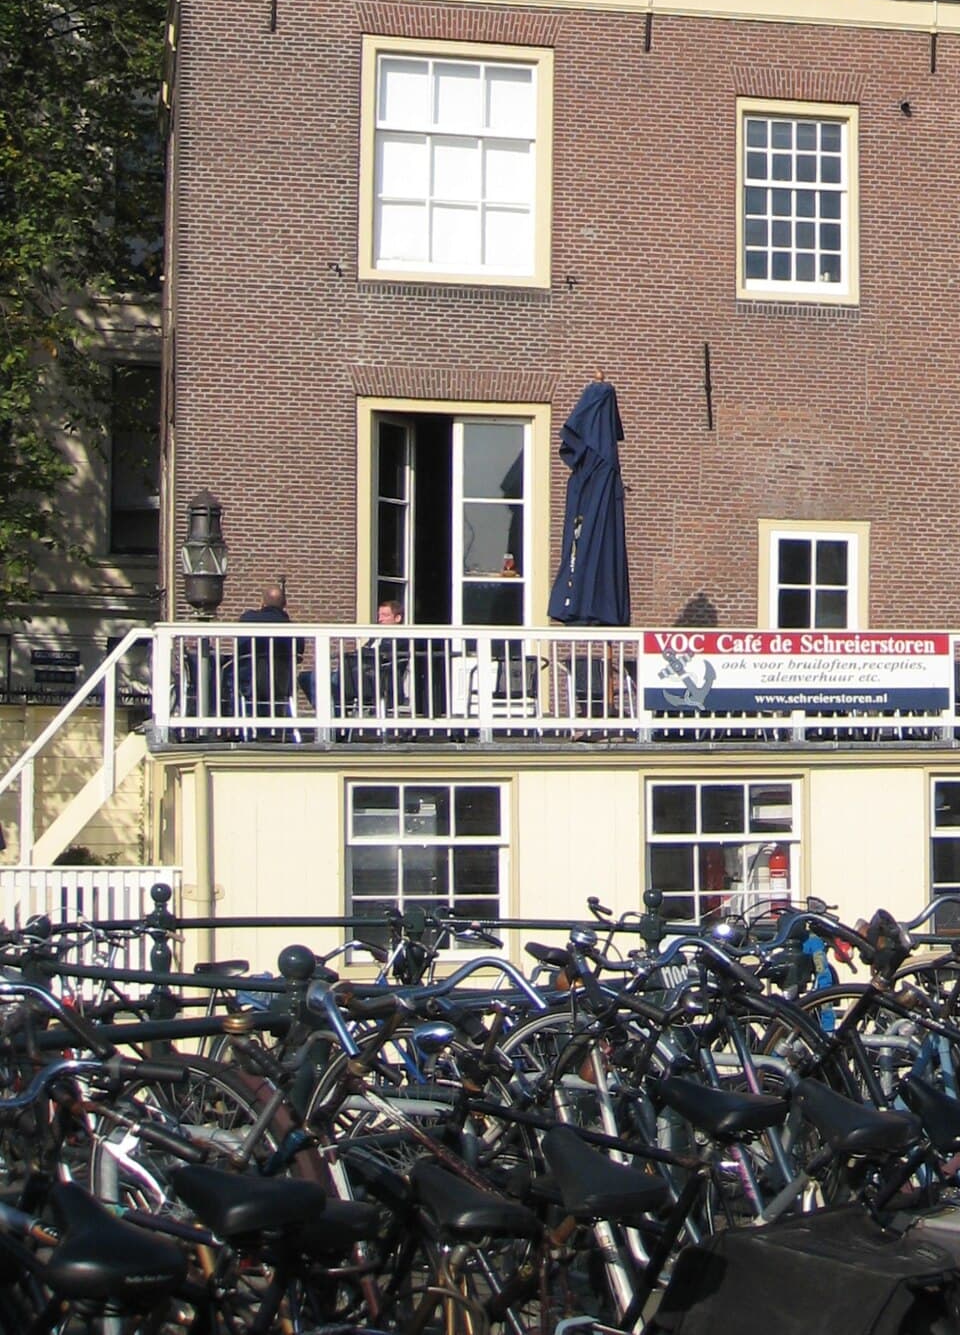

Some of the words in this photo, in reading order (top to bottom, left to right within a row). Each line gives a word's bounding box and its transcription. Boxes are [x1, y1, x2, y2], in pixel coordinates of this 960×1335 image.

[654, 633, 705, 652] VOC
[716, 634, 762, 653] Café
[769, 634, 793, 653] de
[800, 634, 935, 653] Schreierstoren
[721, 659, 747, 670] ook
[753, 661, 783, 670] voor
[760, 672, 854, 683] zalenverhuur
[858, 673, 881, 682] etc.
[754, 693, 888, 704] www.schreierstoren.nl
